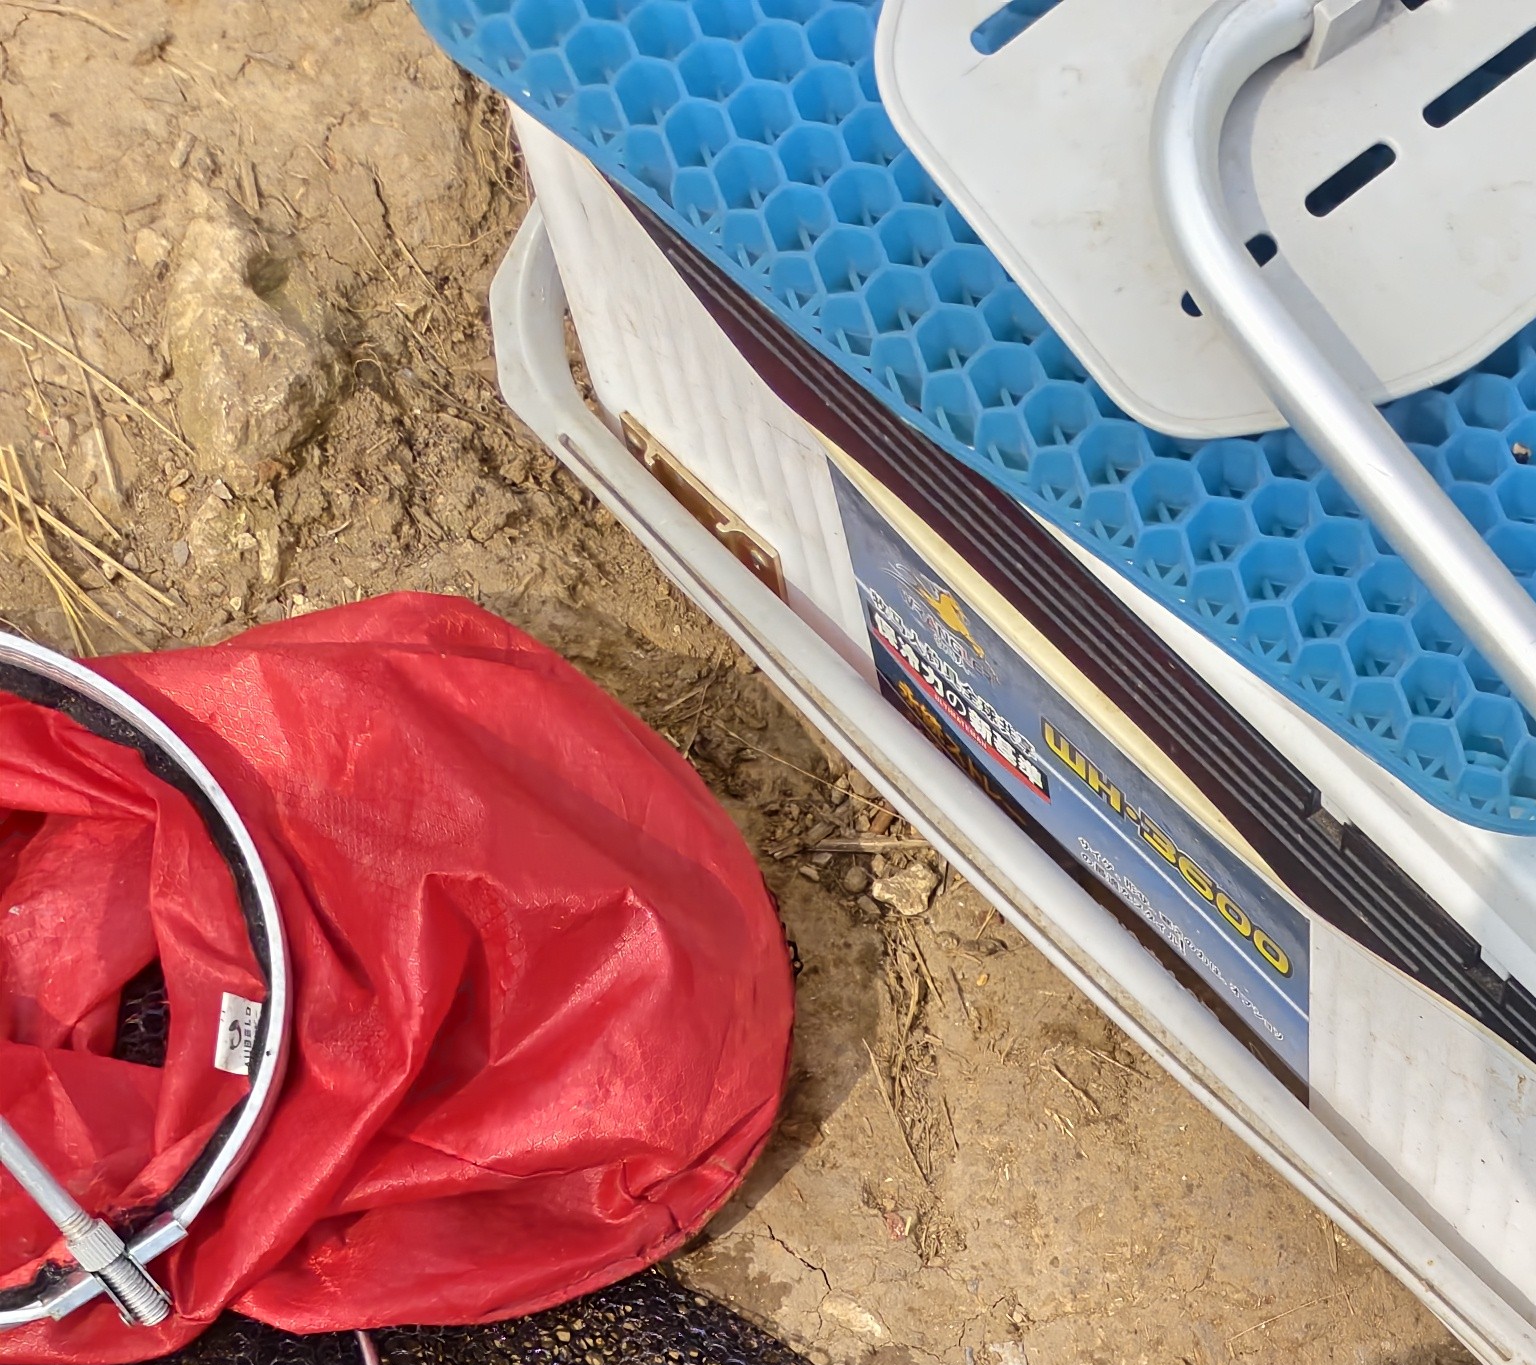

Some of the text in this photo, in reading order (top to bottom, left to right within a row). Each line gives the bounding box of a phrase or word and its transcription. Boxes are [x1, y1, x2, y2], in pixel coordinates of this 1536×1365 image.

[874, 613, 1042, 789] 保冷力の新基準
